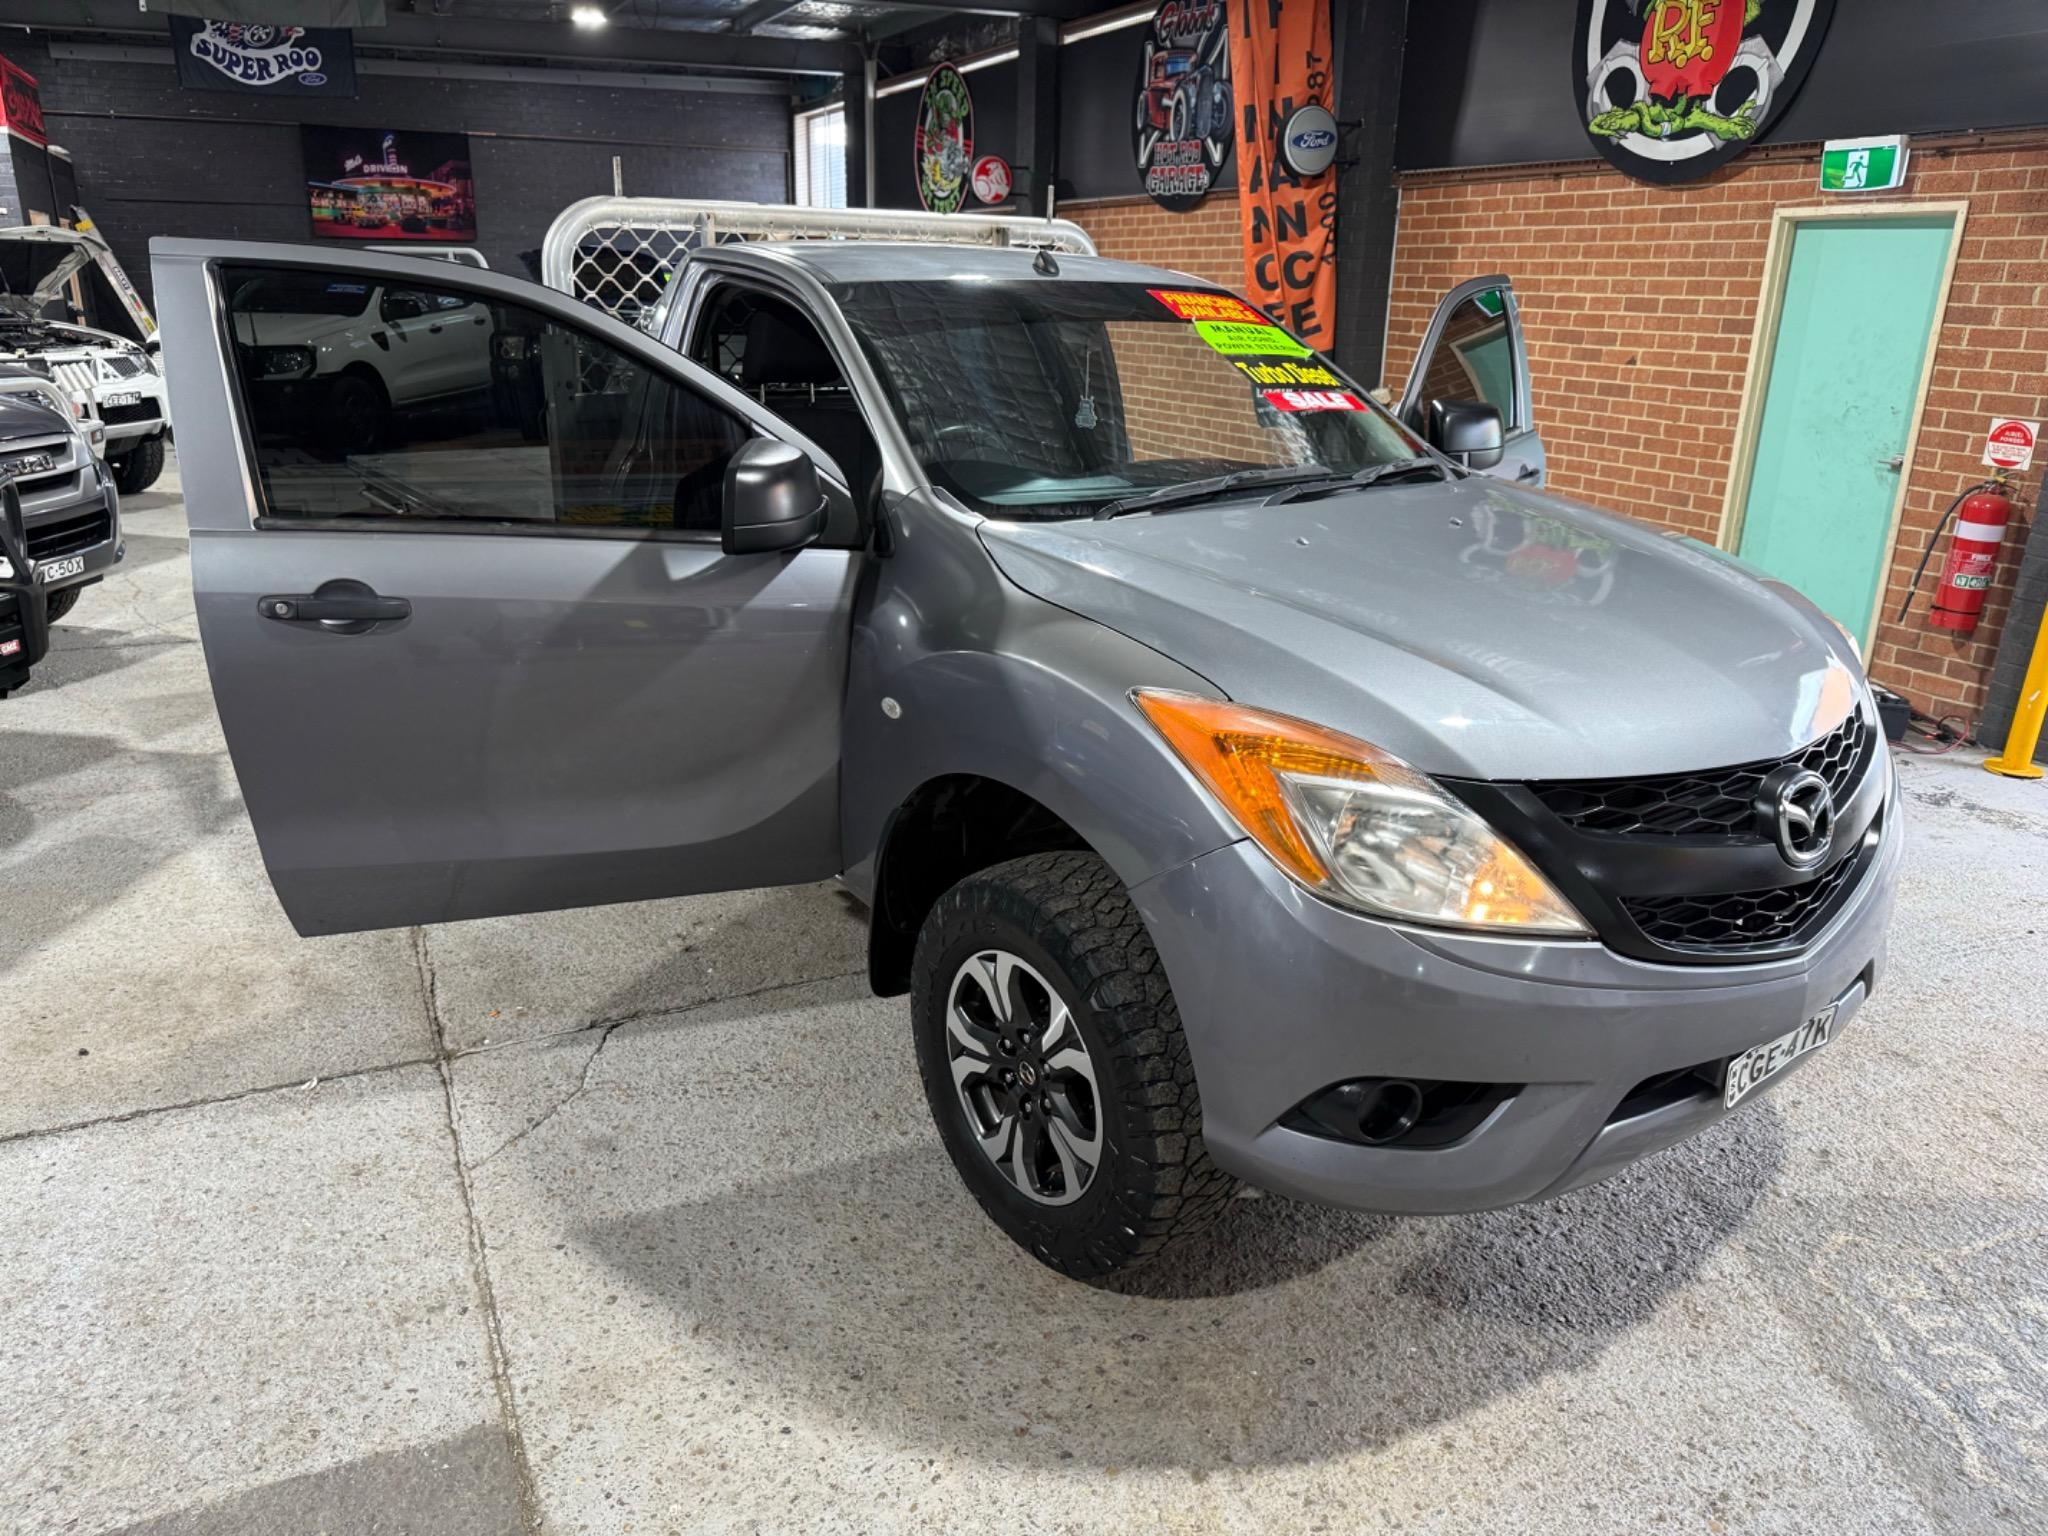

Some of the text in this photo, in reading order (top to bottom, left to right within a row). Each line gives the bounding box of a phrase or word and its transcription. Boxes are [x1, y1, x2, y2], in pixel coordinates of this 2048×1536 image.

[196, 38, 319, 81] SUPER ROO
[940, 69, 969, 117] SPEED
[1300, 130, 1330, 148] Ford
[1154, 139, 1201, 166] HOT ROD
[1150, 163, 1206, 196] GARAGE
[1160, 292, 1245, 310] FINANCING
[1179, 305, 1260, 323] AVAILABLE
[1211, 324, 1273, 337] MANUAL
[1215, 341, 1307, 354] POWER STEERING
[1234, 361, 1341, 387] Turbo Diesel
[1282, 391, 1356, 410] SALE
